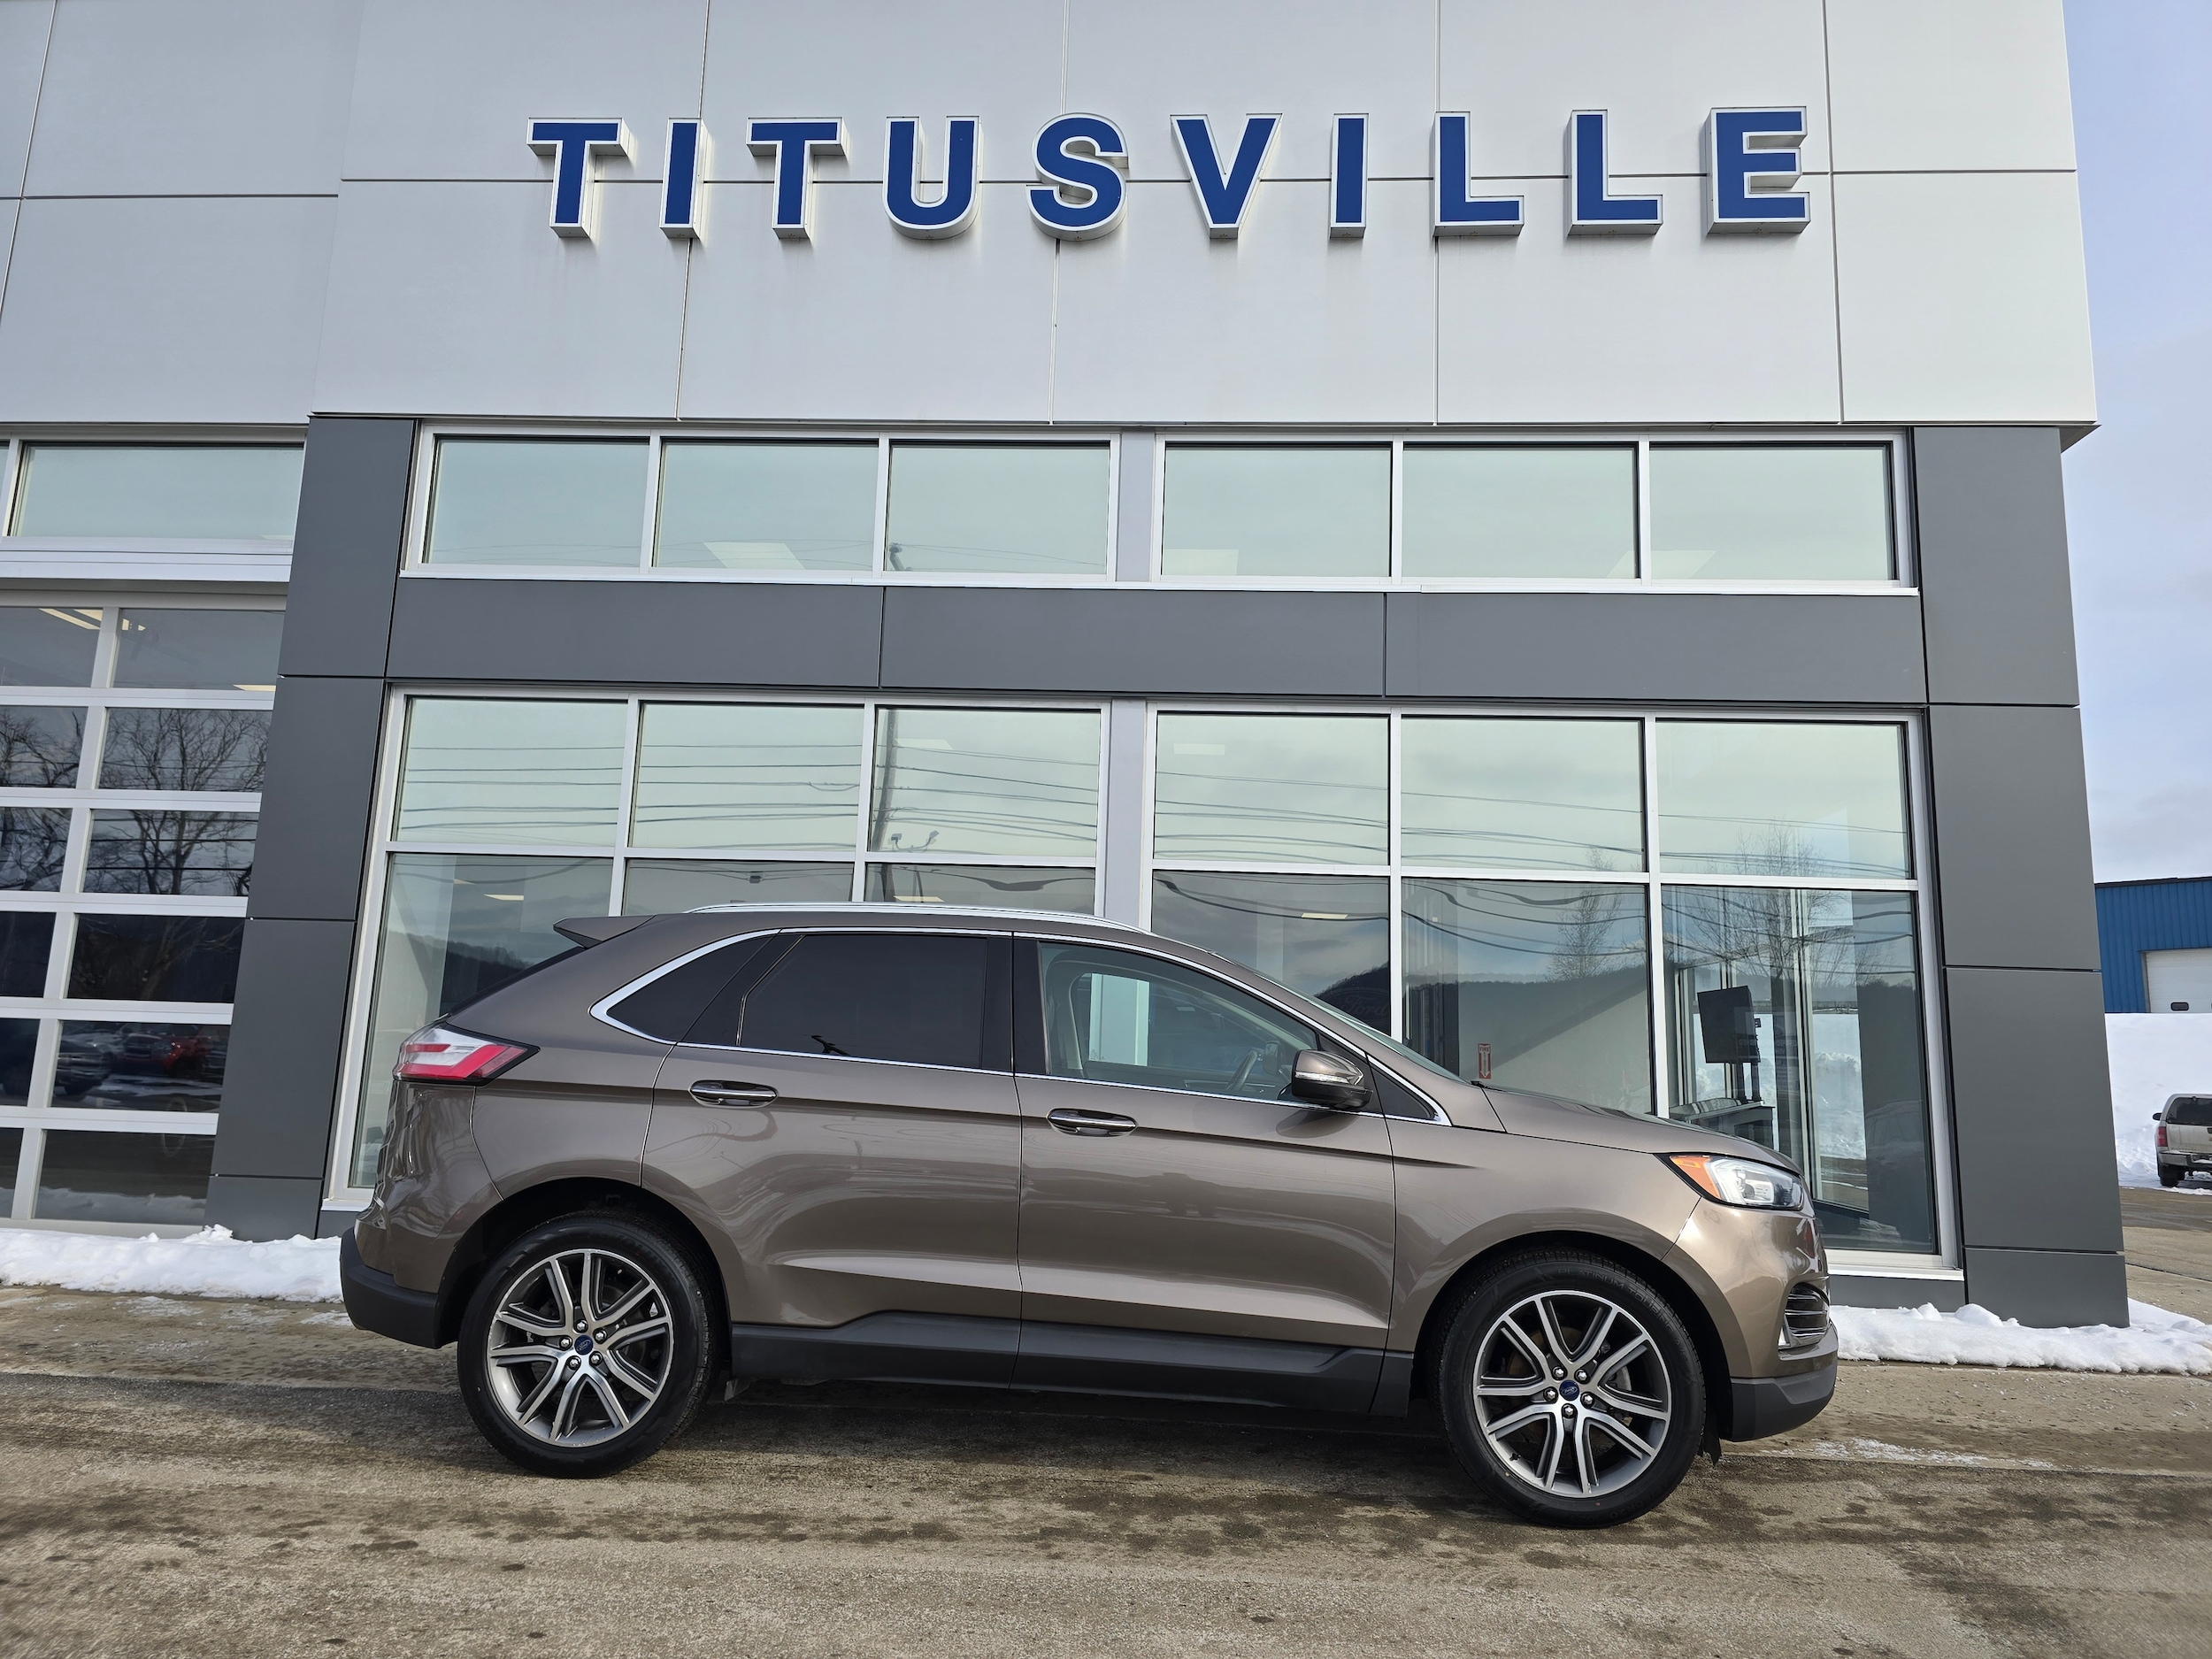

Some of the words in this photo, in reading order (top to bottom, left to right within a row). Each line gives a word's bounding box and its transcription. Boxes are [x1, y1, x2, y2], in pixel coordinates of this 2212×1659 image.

[527, 107, 1809, 237] TITUSVILLE
[1341, 995, 1388, 1018] Ford
[1557, 1266, 1626, 1289] PLATINUM
